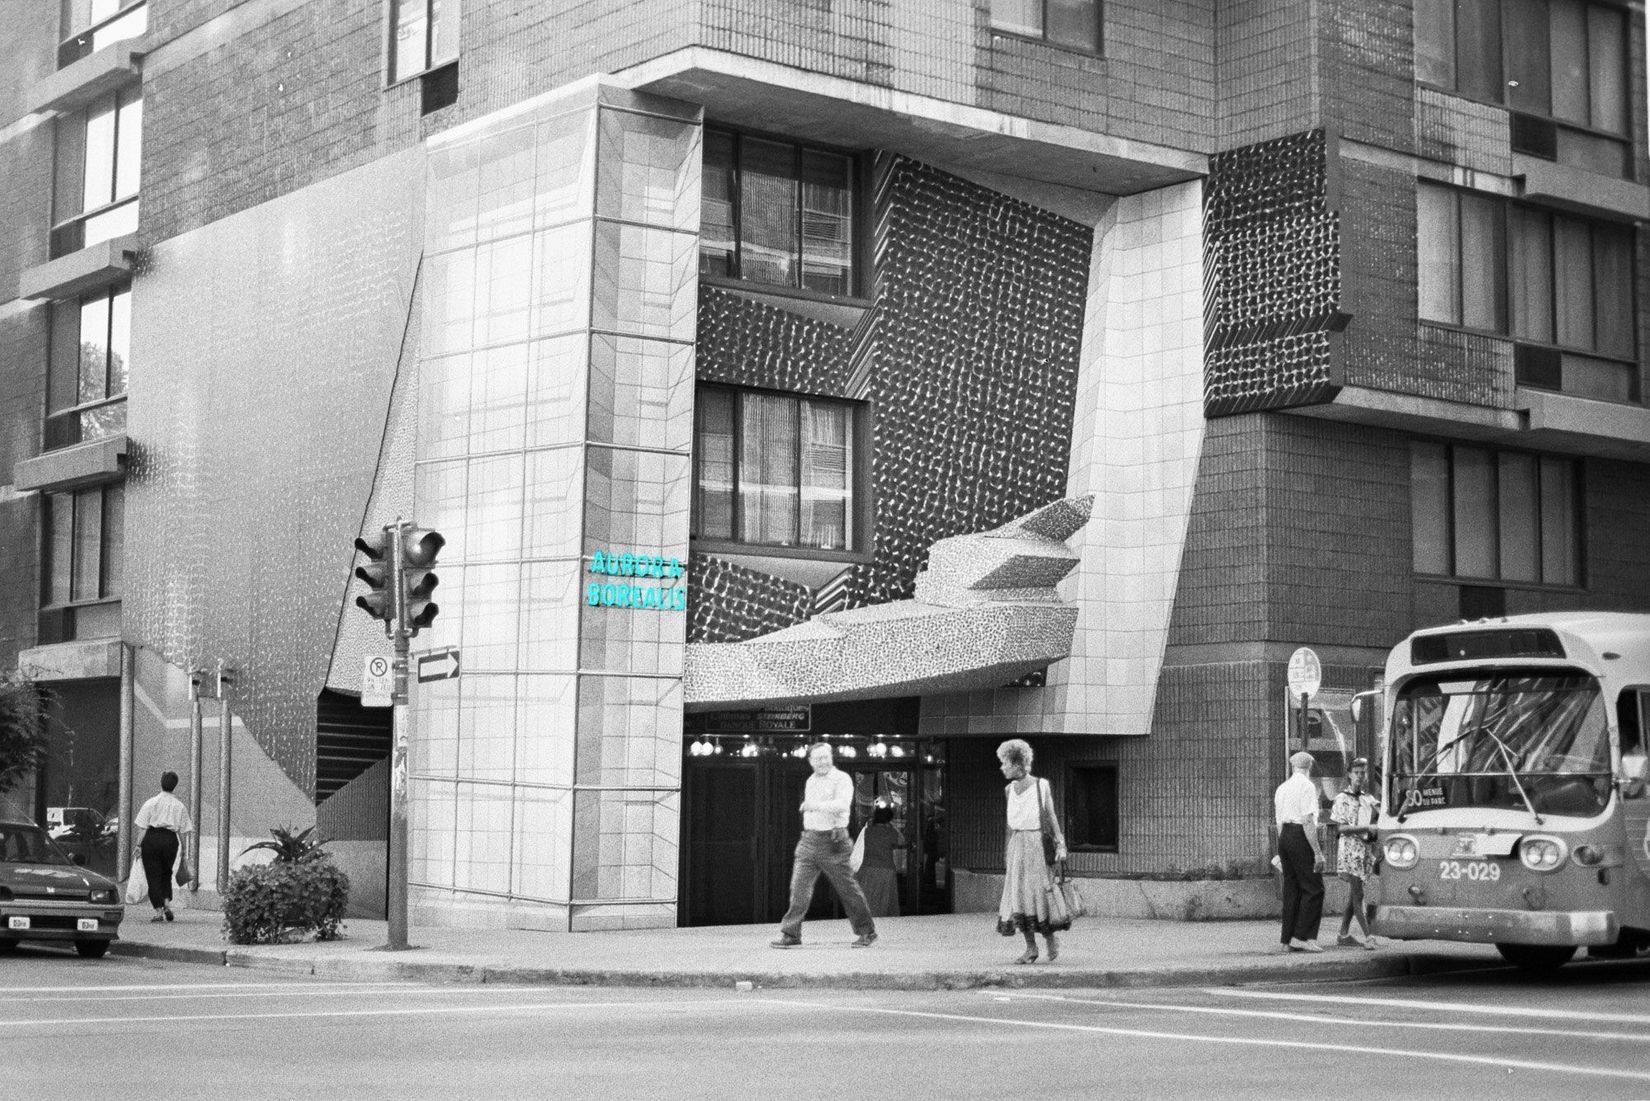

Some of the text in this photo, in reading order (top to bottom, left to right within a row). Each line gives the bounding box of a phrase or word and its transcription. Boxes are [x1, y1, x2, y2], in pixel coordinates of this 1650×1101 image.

[591, 549, 683, 577] AURORA
[587, 582, 685, 611] BOREALIS
[1440, 861, 1501, 881] 23-029
